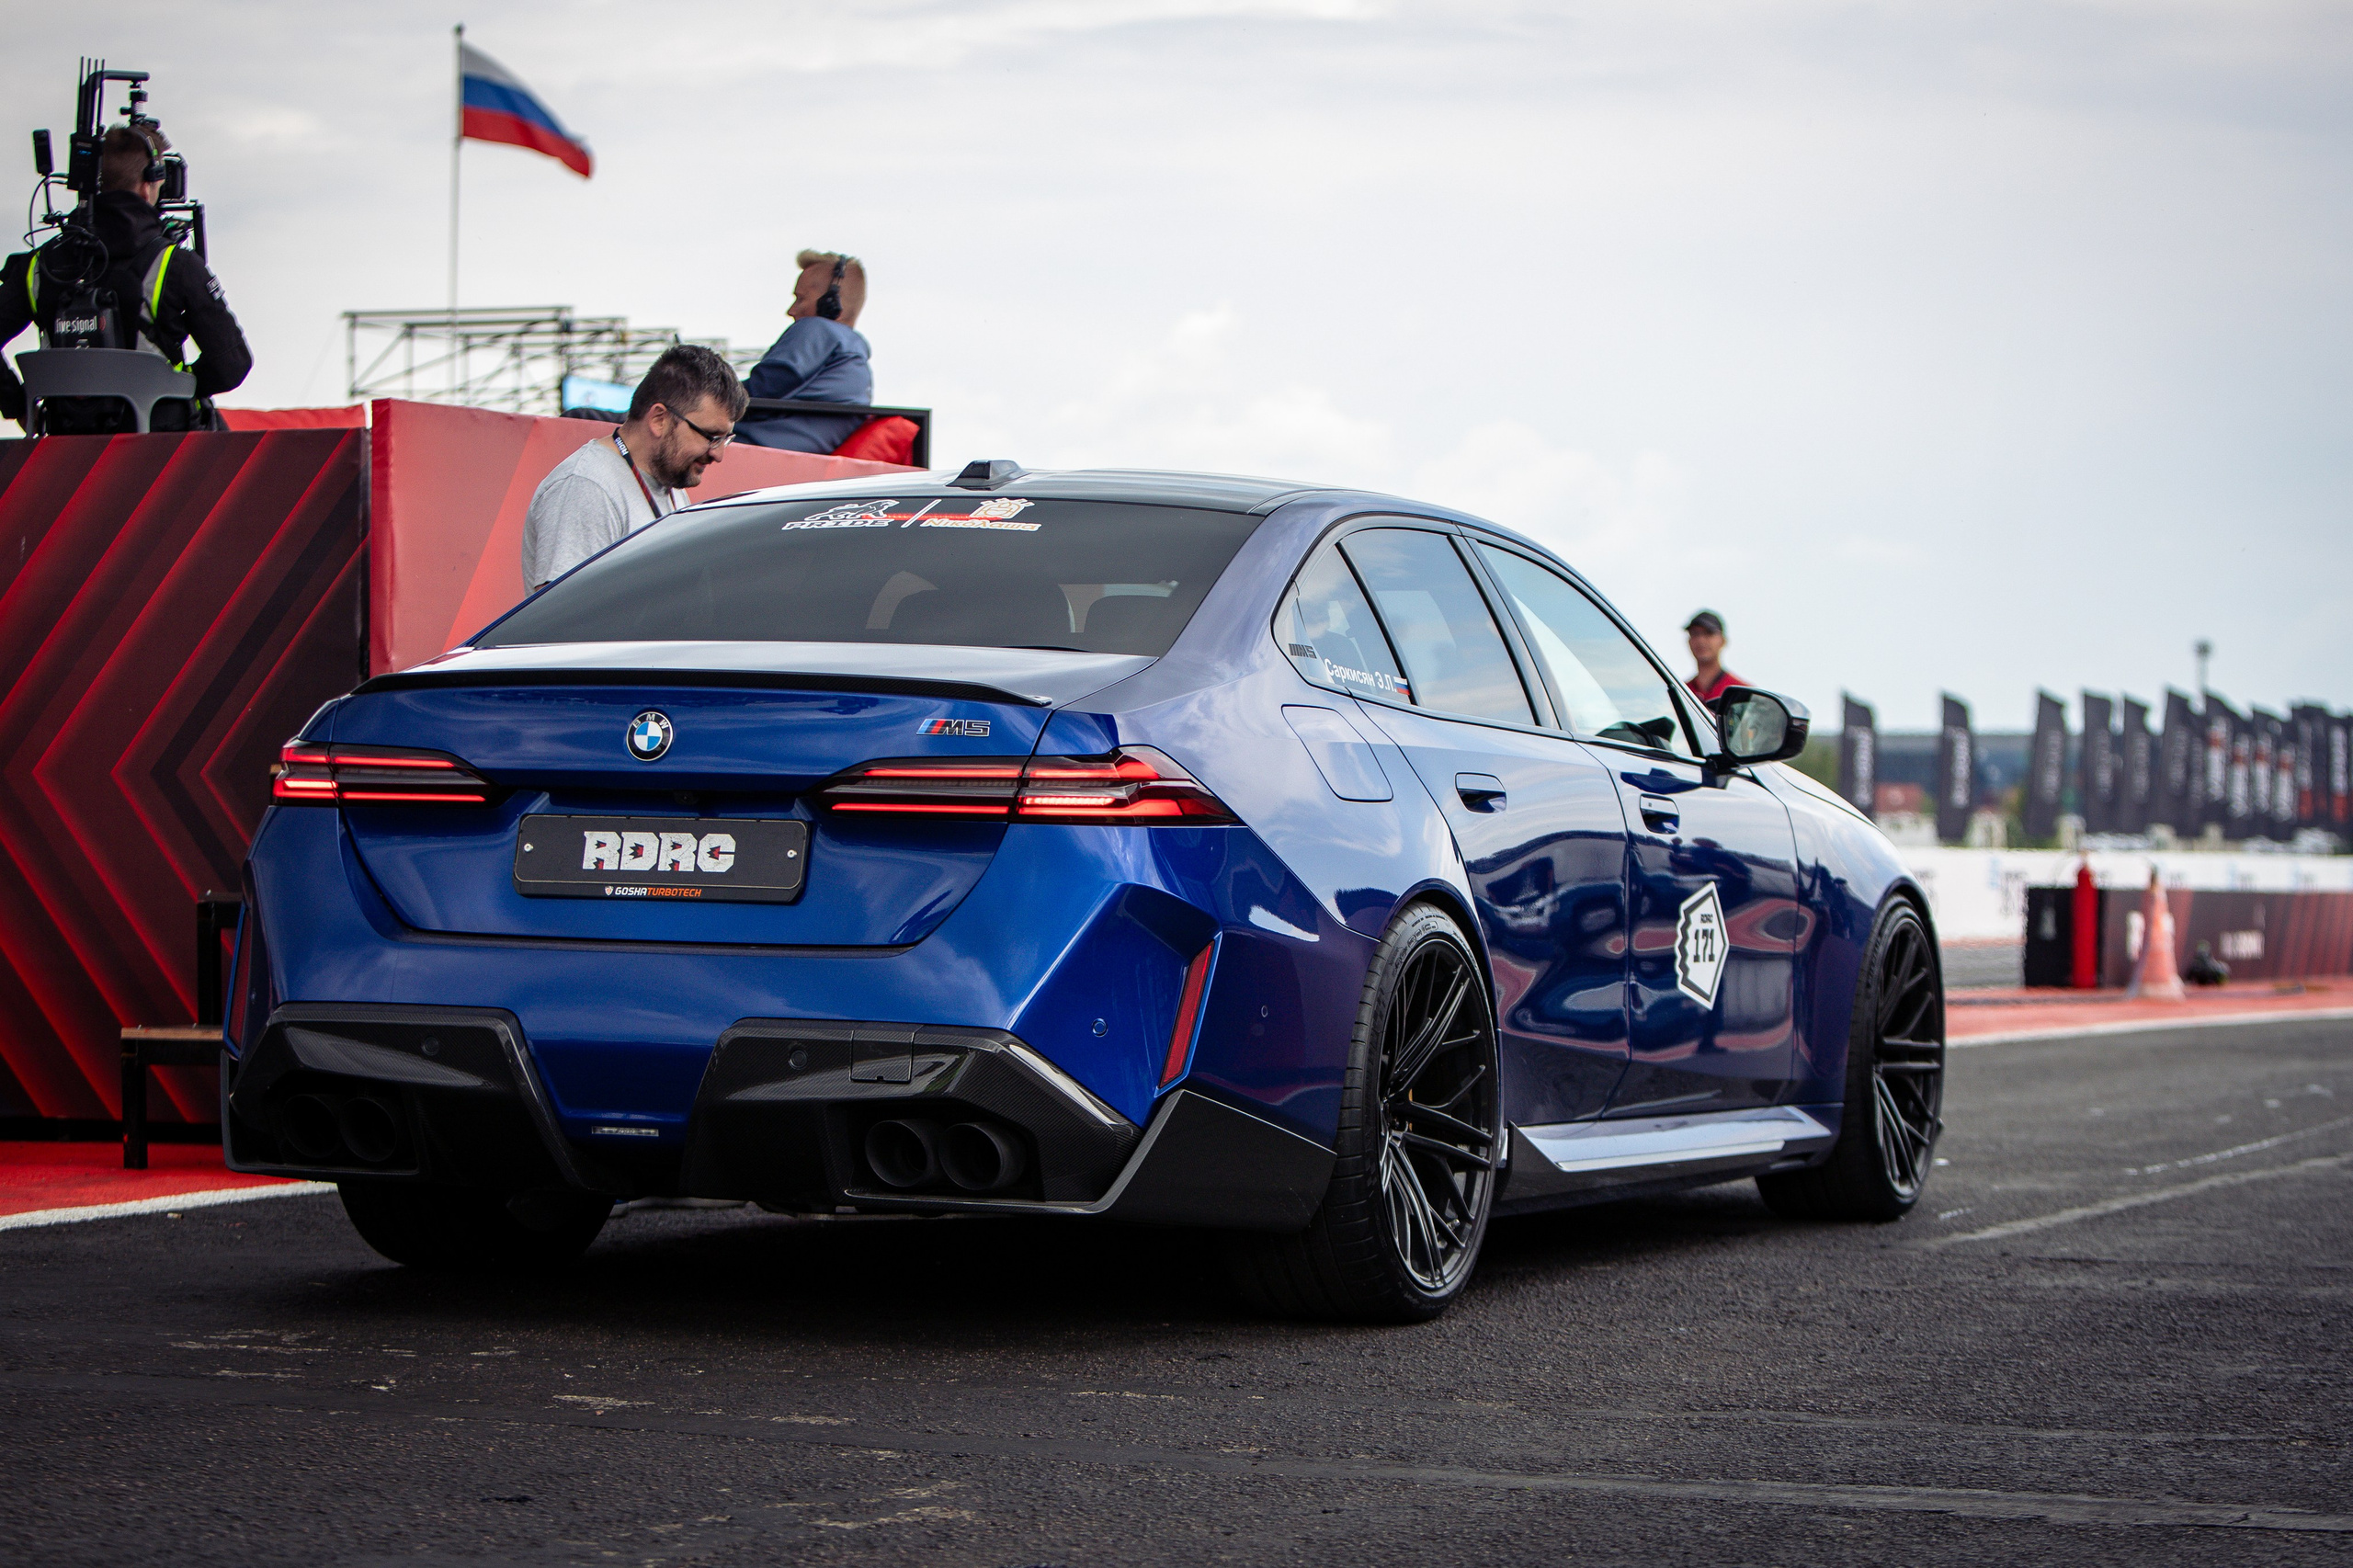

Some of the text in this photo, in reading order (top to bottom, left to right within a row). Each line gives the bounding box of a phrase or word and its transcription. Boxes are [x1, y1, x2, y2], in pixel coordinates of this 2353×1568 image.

[781, 519, 894, 530] PRIDE
[1324, 658, 1375, 686] Саркисян
[632, 713, 669, 729] BMW
[934, 719, 991, 737] M5
[583, 831, 736, 872] RDRC
[1693, 928, 1715, 963] 171
